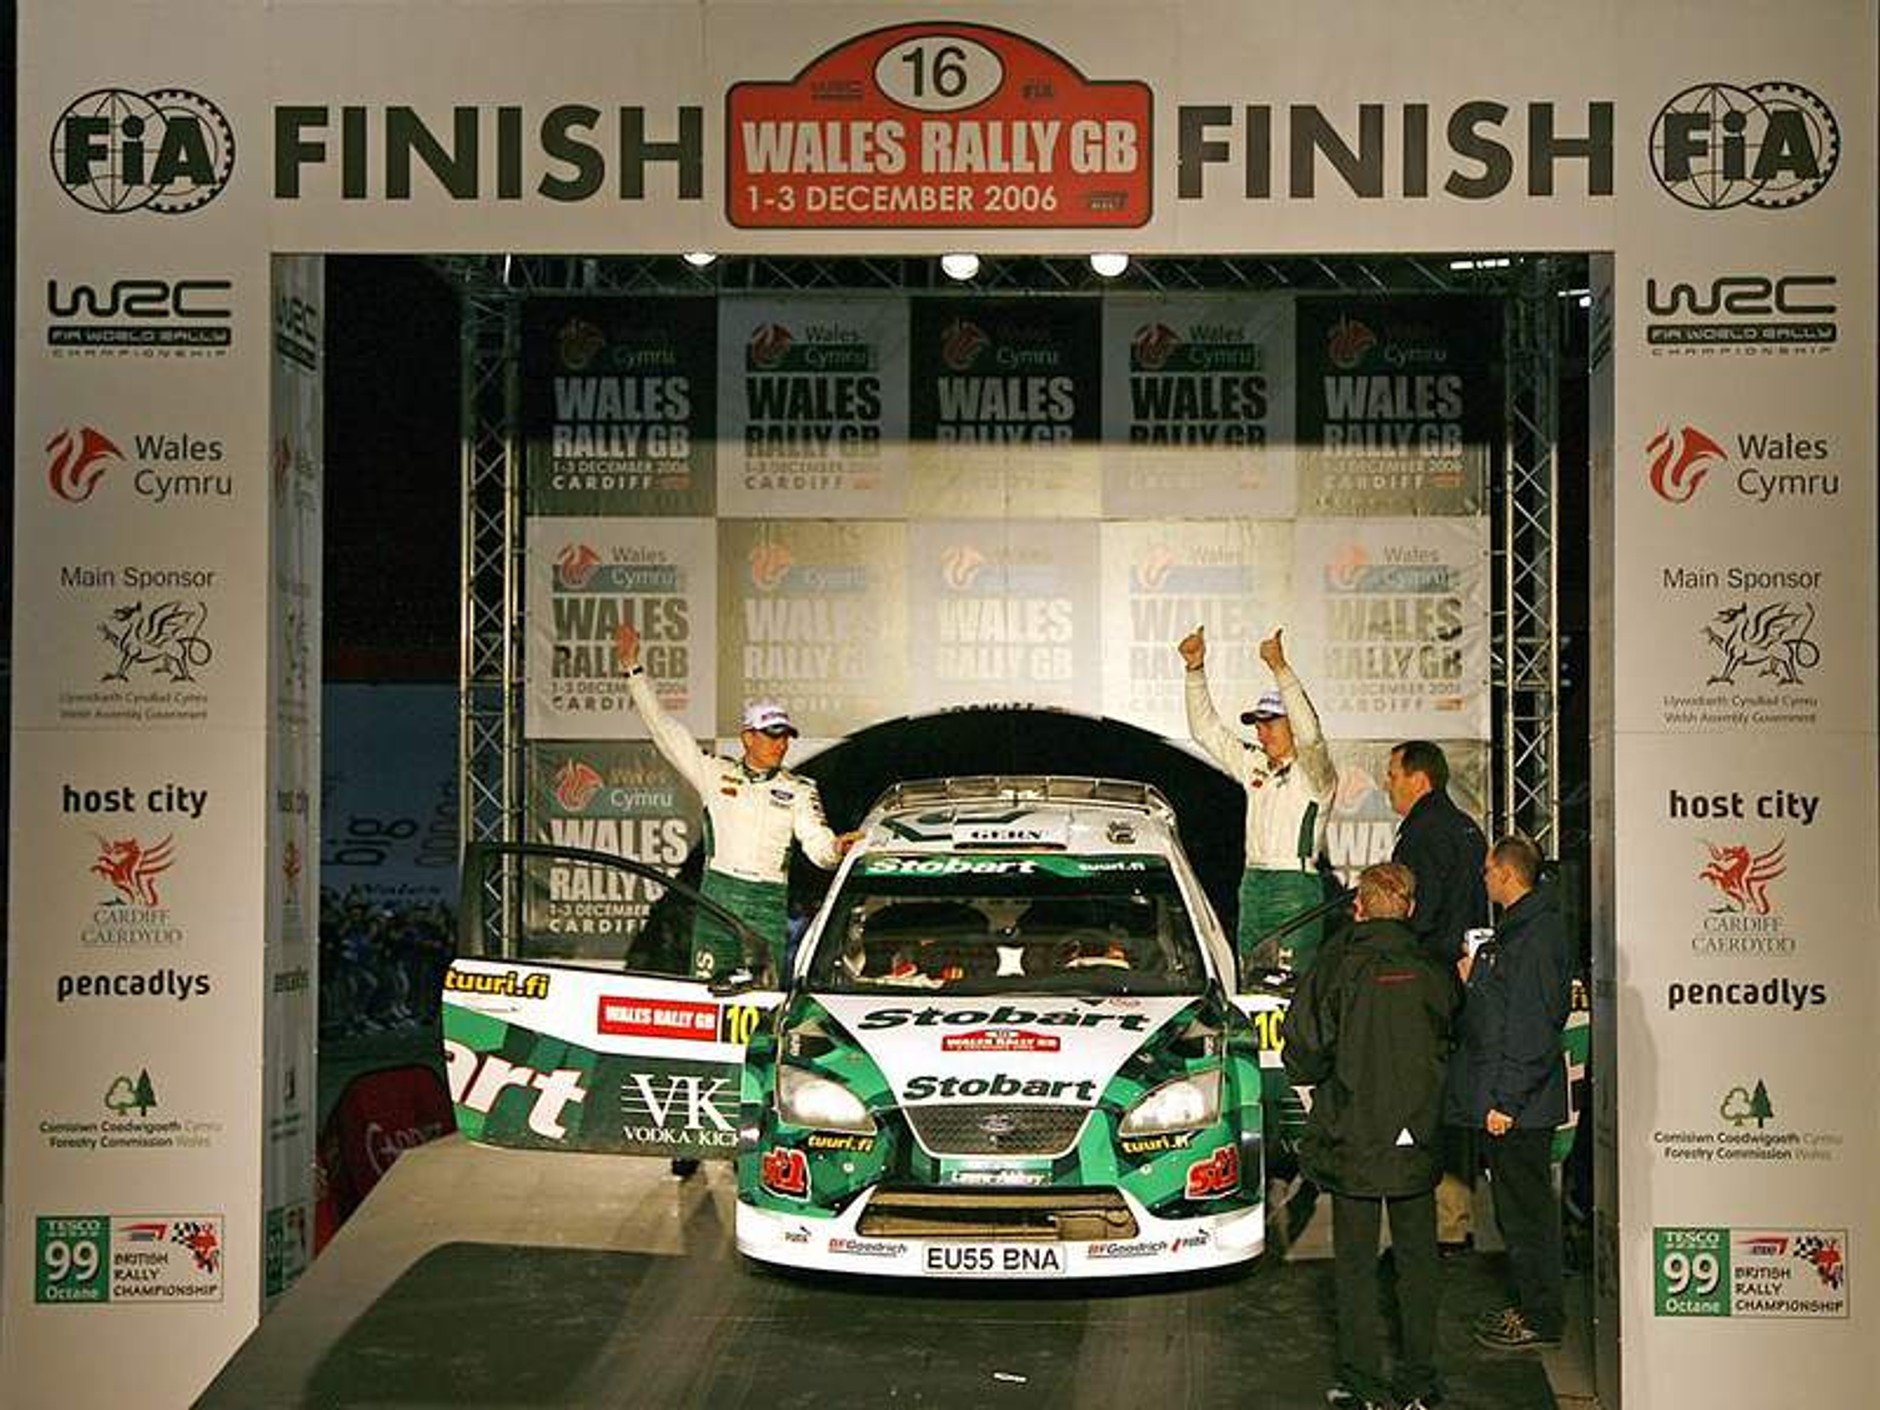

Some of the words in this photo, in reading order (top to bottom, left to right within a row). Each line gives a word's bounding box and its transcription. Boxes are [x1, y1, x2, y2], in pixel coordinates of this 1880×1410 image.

[901, 47, 967, 98] 16
[274, 104, 704, 202] FINISH
[742, 120, 906, 173] WALES
[921, 121, 1060, 173] RALLY
[1070, 120, 1137, 173] GB
[1178, 101, 1614, 199] FINISH
[747, 187, 795, 212] 1-3
[807, 186, 974, 211] DECEMBER
[984, 186, 1056, 211] 2006
[48, 280, 232, 318] WRC
[1647, 277, 1837, 316] WRC
[1687, 328, 1757, 340] WORLD
[1763, 327, 1833, 340] RALLY
[553, 376, 691, 420] WALES
[745, 376, 881, 420] WALES
[937, 376, 1075, 420] WALES
[1130, 376, 1267, 420] WALES
[1323, 375, 1463, 419] WALES
[135, 433, 222, 461] Wales
[553, 424, 642, 458] RALLY
[648, 424, 690, 458] GB
[1737, 433, 1827, 460] Wales
[134, 469, 232, 502] Cymru
[552, 475, 651, 490] CARDIFF
[745, 475, 842, 490] CARDIFF
[1737, 468, 1839, 502] Cymru
[61, 567, 115, 588] Main
[123, 566, 217, 592] Sponsor
[1663, 568, 1719, 589] Main
[1727, 568, 1822, 592] Sponsor
[939, 598, 1073, 642] WALES
[646, 645, 689, 678] GB
[63, 785, 136, 812] host
[148, 785, 208, 819] city
[610, 788, 672, 812] Cymru
[1670, 790, 1744, 818] host
[1757, 790, 1819, 825] city
[551, 819, 688, 864] WALES
[869, 858, 1038, 873] Stobart
[550, 867, 637, 900] RALLY
[94, 910, 170, 924] CARDIFF
[1703, 917, 1783, 932] CARDIFF
[57, 970, 211, 1001] pencadlys
[445, 969, 549, 998] tuuri.fi
[1668, 978, 1827, 1010] pencadlys
[605, 1006, 652, 1025] WALES
[653, 1009, 692, 1028] RALLY
[695, 1013, 715, 1029] GB
[858, 1005, 1151, 1031] Stobart
[903, 1075, 1097, 1100] Stobart
[630, 1074, 737, 1132] VK
[101, 1136, 173, 1148] Commission
[622, 1126, 691, 1144] VODKA
[1717, 1148, 1792, 1160] Commission
[48, 1220, 100, 1230] TESCO
[1664, 1232, 1719, 1243] TESCO
[44, 1240, 99, 1283] 99
[113, 1253, 168, 1265] BRITISH
[927, 1247, 994, 1270] EU55
[1003, 1247, 1059, 1270] BNA
[113, 1269, 159, 1280] RALLY
[1663, 1252, 1719, 1296] 99
[1735, 1267, 1791, 1279] BRITISH
[113, 1285, 217, 1297] CHAMPIONSHIP
[1735, 1283, 1782, 1295] RALLY
[1666, 1299, 1720, 1313] Octane
[1735, 1300, 1844, 1313] CHAMPIONSHIP
